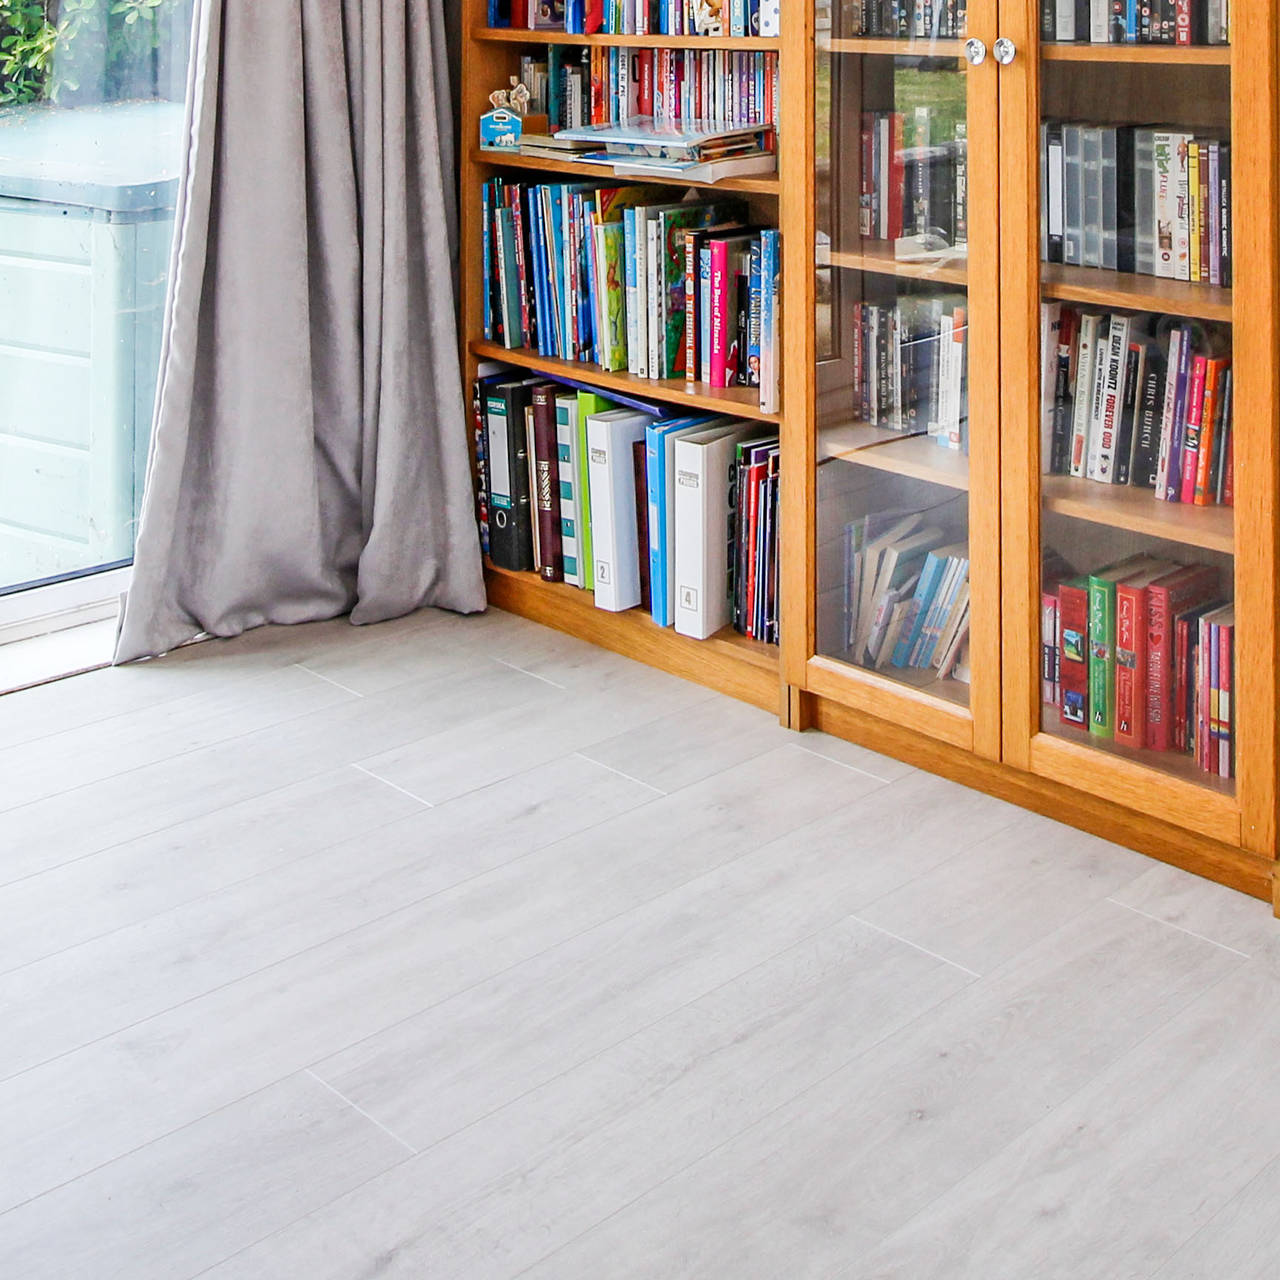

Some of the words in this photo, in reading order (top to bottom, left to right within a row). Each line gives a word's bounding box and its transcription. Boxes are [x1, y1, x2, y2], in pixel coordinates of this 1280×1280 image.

[713, 271, 722, 288] The
[713, 288, 722, 306] Best
[713, 317, 722, 354] Miranda
[1110, 334, 1122, 358] DEAN
[1106, 358, 1120, 391] KOONTZ
[1144, 373, 1157, 406] CHRIS
[1104, 393, 1116, 430] FOREVER
[1102, 431, 1114, 450] ODD
[1140, 410, 1154, 449] BUNCH
[684, 590, 693, 605] 4
[1148, 589, 1165, 630] KISS
[1149, 695, 1162, 725] WILSON
